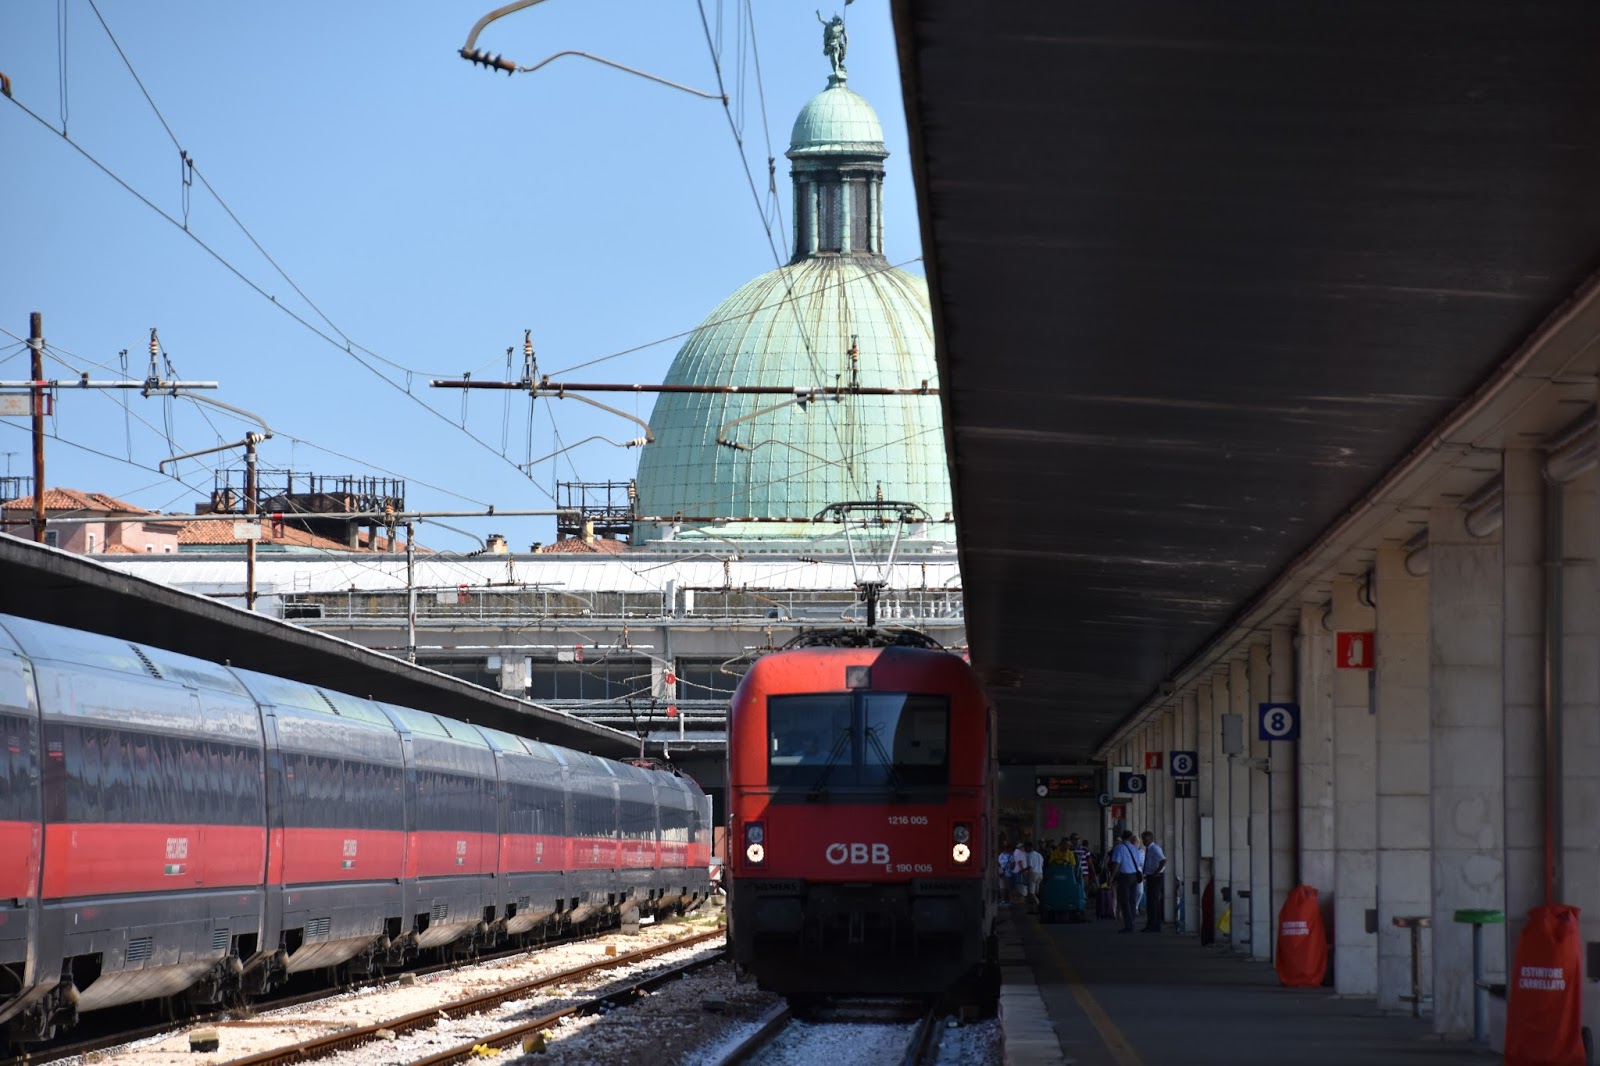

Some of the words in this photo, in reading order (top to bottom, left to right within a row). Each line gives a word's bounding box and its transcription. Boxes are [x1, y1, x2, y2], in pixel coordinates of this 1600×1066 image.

[1271, 712, 1285, 731] 8
[1178, 757, 1188, 770] 8
[1132, 778, 1139, 789] 8
[1102, 795, 1109, 804] 8
[888, 816, 909, 825] 1216
[910, 816, 928, 825] 005
[825, 842, 891, 865] ÖBB
[886, 863, 893, 873] E
[896, 863, 912, 873] 190
[914, 863, 933, 873] 005
[1520, 966, 1564, 978] ESTINTORE
[1519, 978, 1566, 991] CARRELLATO
